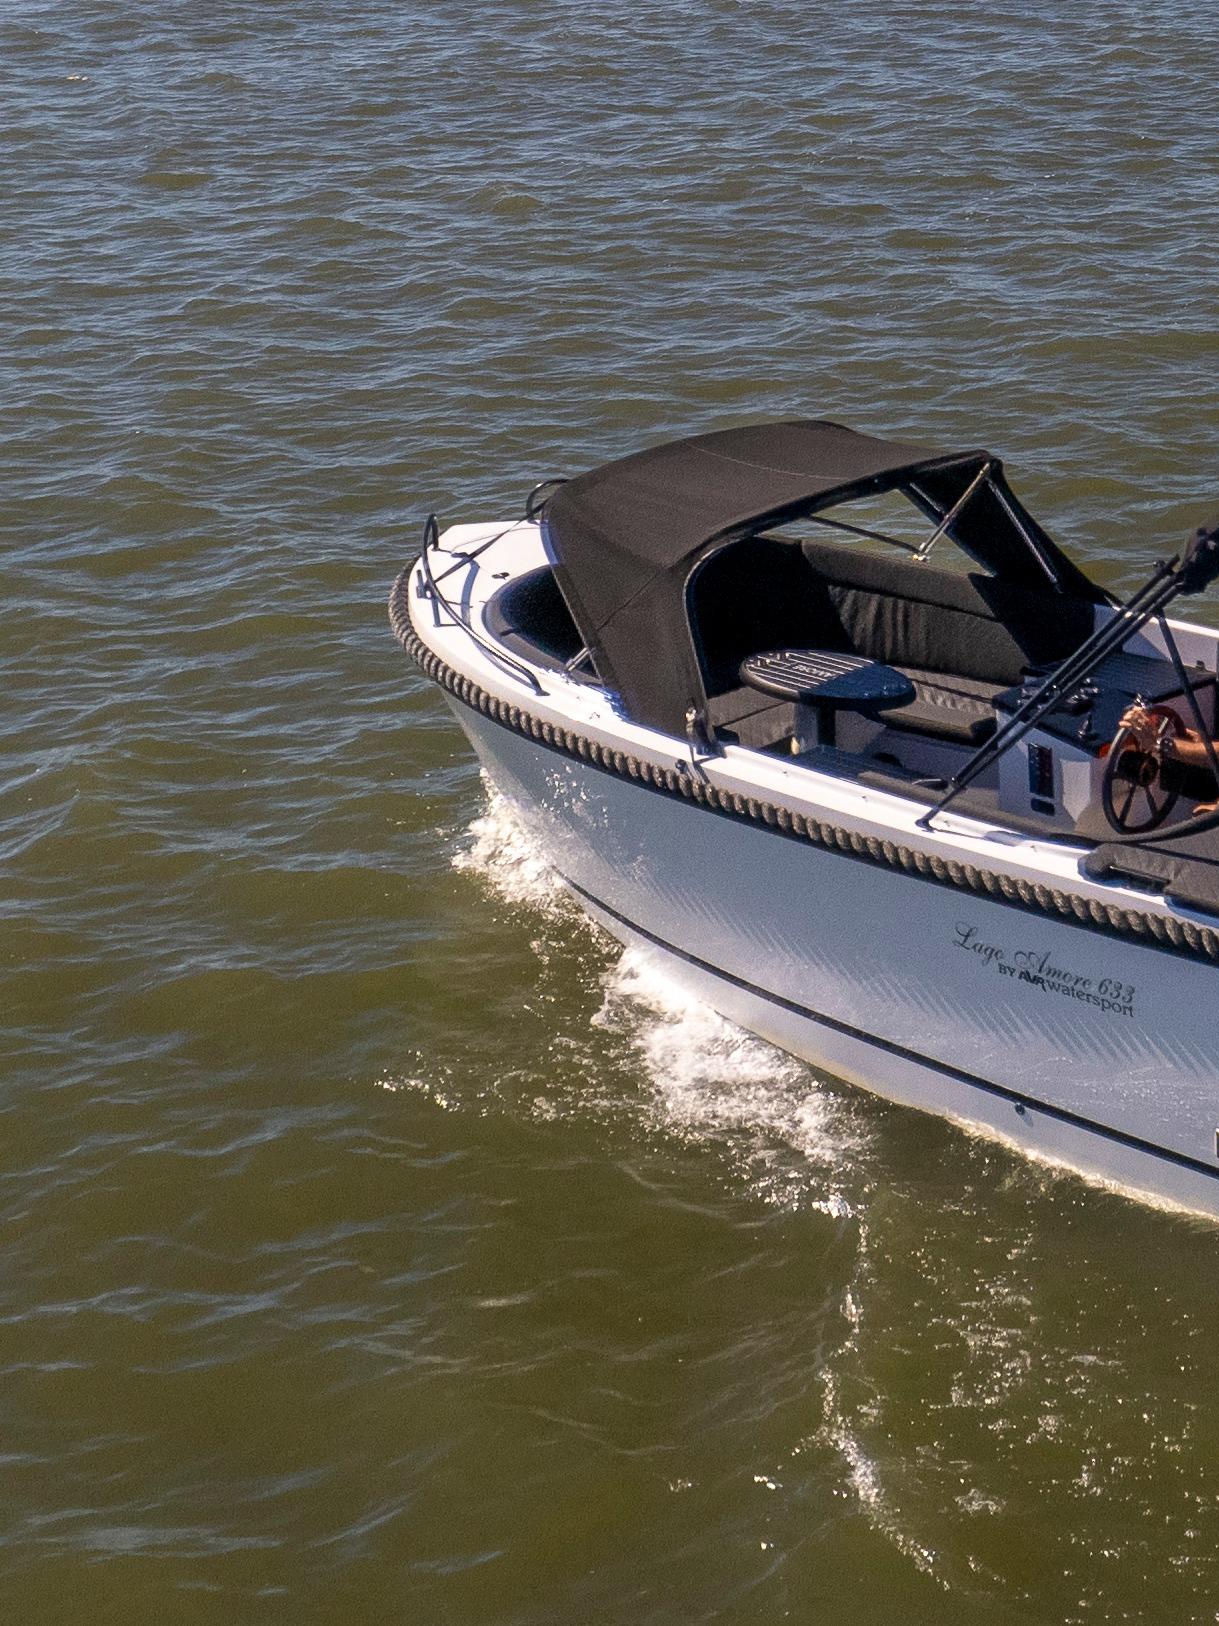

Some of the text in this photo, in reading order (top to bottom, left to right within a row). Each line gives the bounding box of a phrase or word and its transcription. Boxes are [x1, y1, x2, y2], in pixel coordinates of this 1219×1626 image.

[952, 921, 1136, 1004] Lago Amore 633
[998, 963, 1017, 978] BY
